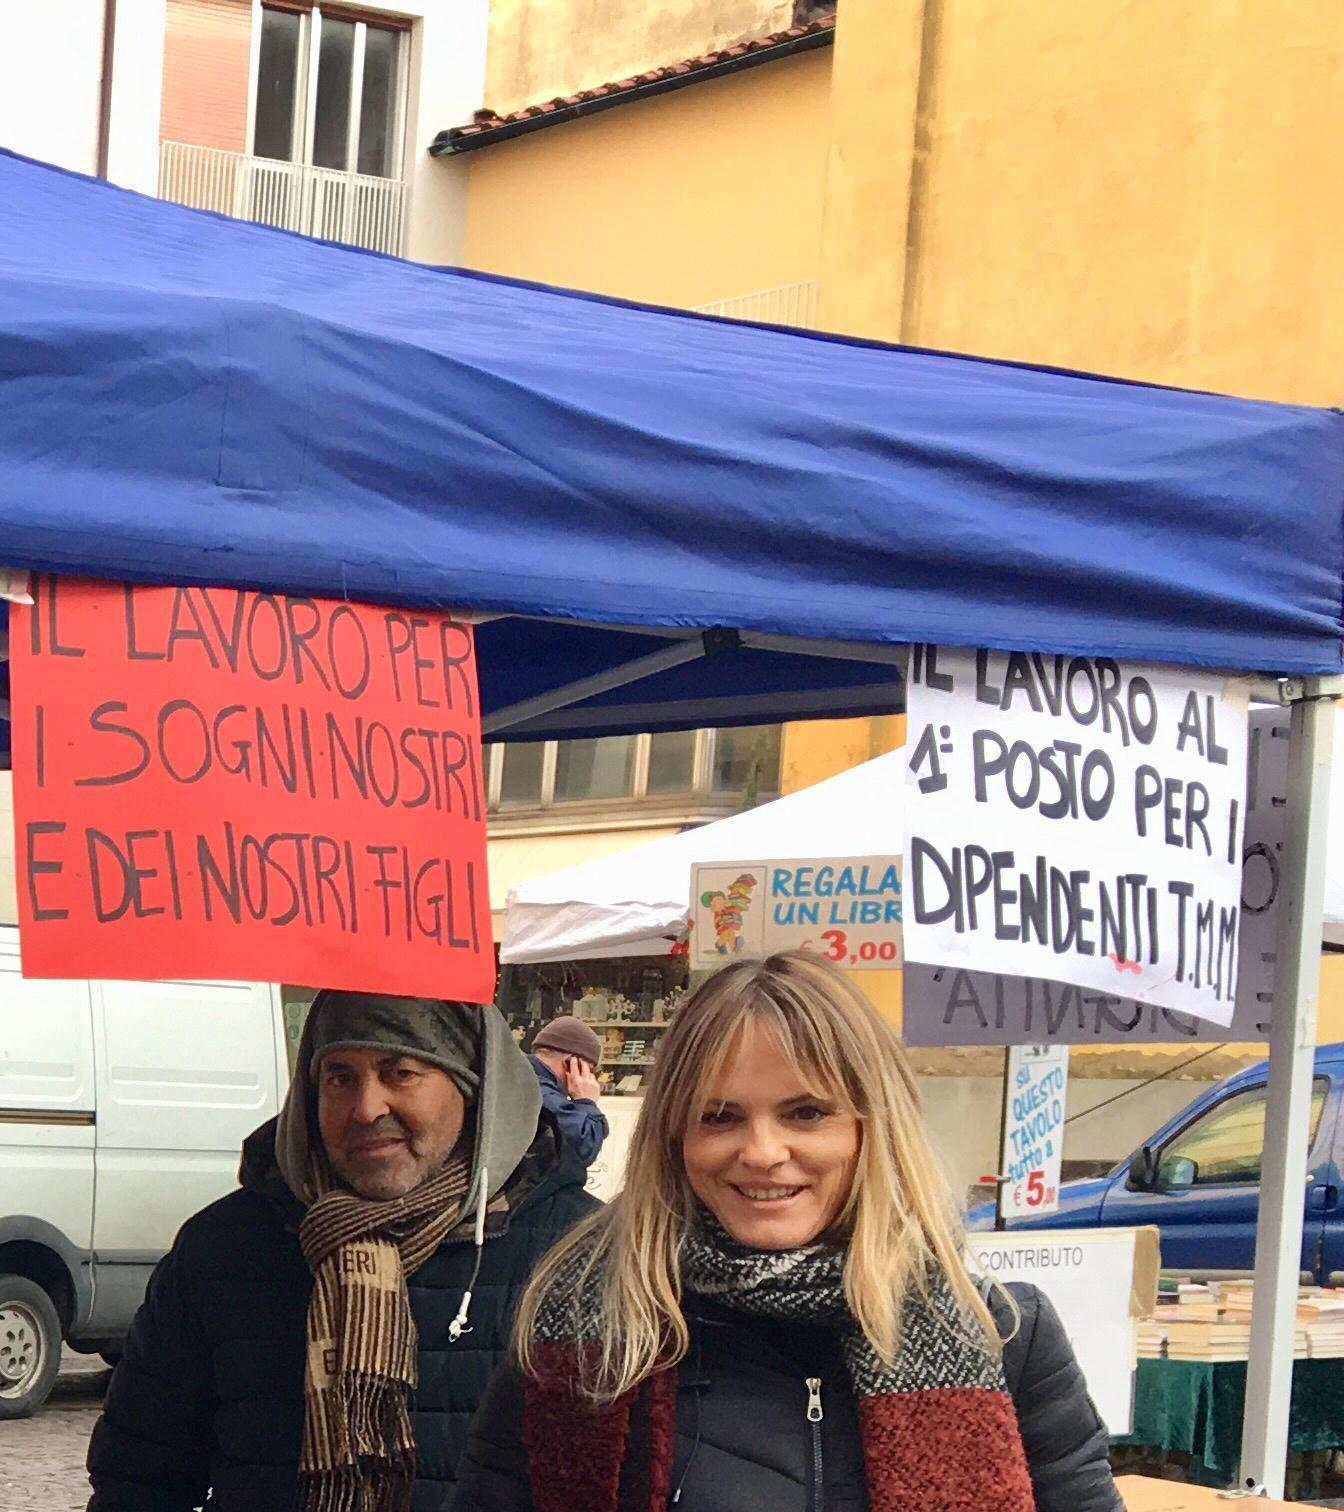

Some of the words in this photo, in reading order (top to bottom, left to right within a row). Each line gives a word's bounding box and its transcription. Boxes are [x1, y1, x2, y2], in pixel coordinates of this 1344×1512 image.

[30, 573, 86, 656] IL
[123, 583, 371, 700] LAVORO
[383, 613, 475, 718] PER
[913, 643, 954, 692] IL
[976, 648, 1158, 747] LAVORO
[1177, 690, 1228, 766] AL
[35, 705, 45, 787] I
[73, 700, 317, 799] SOGNI
[326, 712, 481, 822] NOSTRI
[972, 729, 1116, 820] POSTO
[1134, 764, 1213, 856] PER
[1227, 799, 1239, 864] I
[26, 821, 69, 922] E
[85, 827, 182, 924] DEI
[196, 821, 358, 934] NOSTRI
[365, 845, 480, 954] FIGLI
[771, 865, 902, 898] REGALA
[911, 836, 1160, 966] DIPENDENTI
[773, 901, 819, 926] UN
[820, 930, 897, 965] 3,00
[1012, 1066, 1063, 1122] QUESTO
[1015, 1064, 1031, 1089] SU
[1010, 1099, 1062, 1156] TAVOLO
[1008, 1147, 1043, 1184] tutto
[978, 1247, 1084, 1271] CONTRIBUTO
